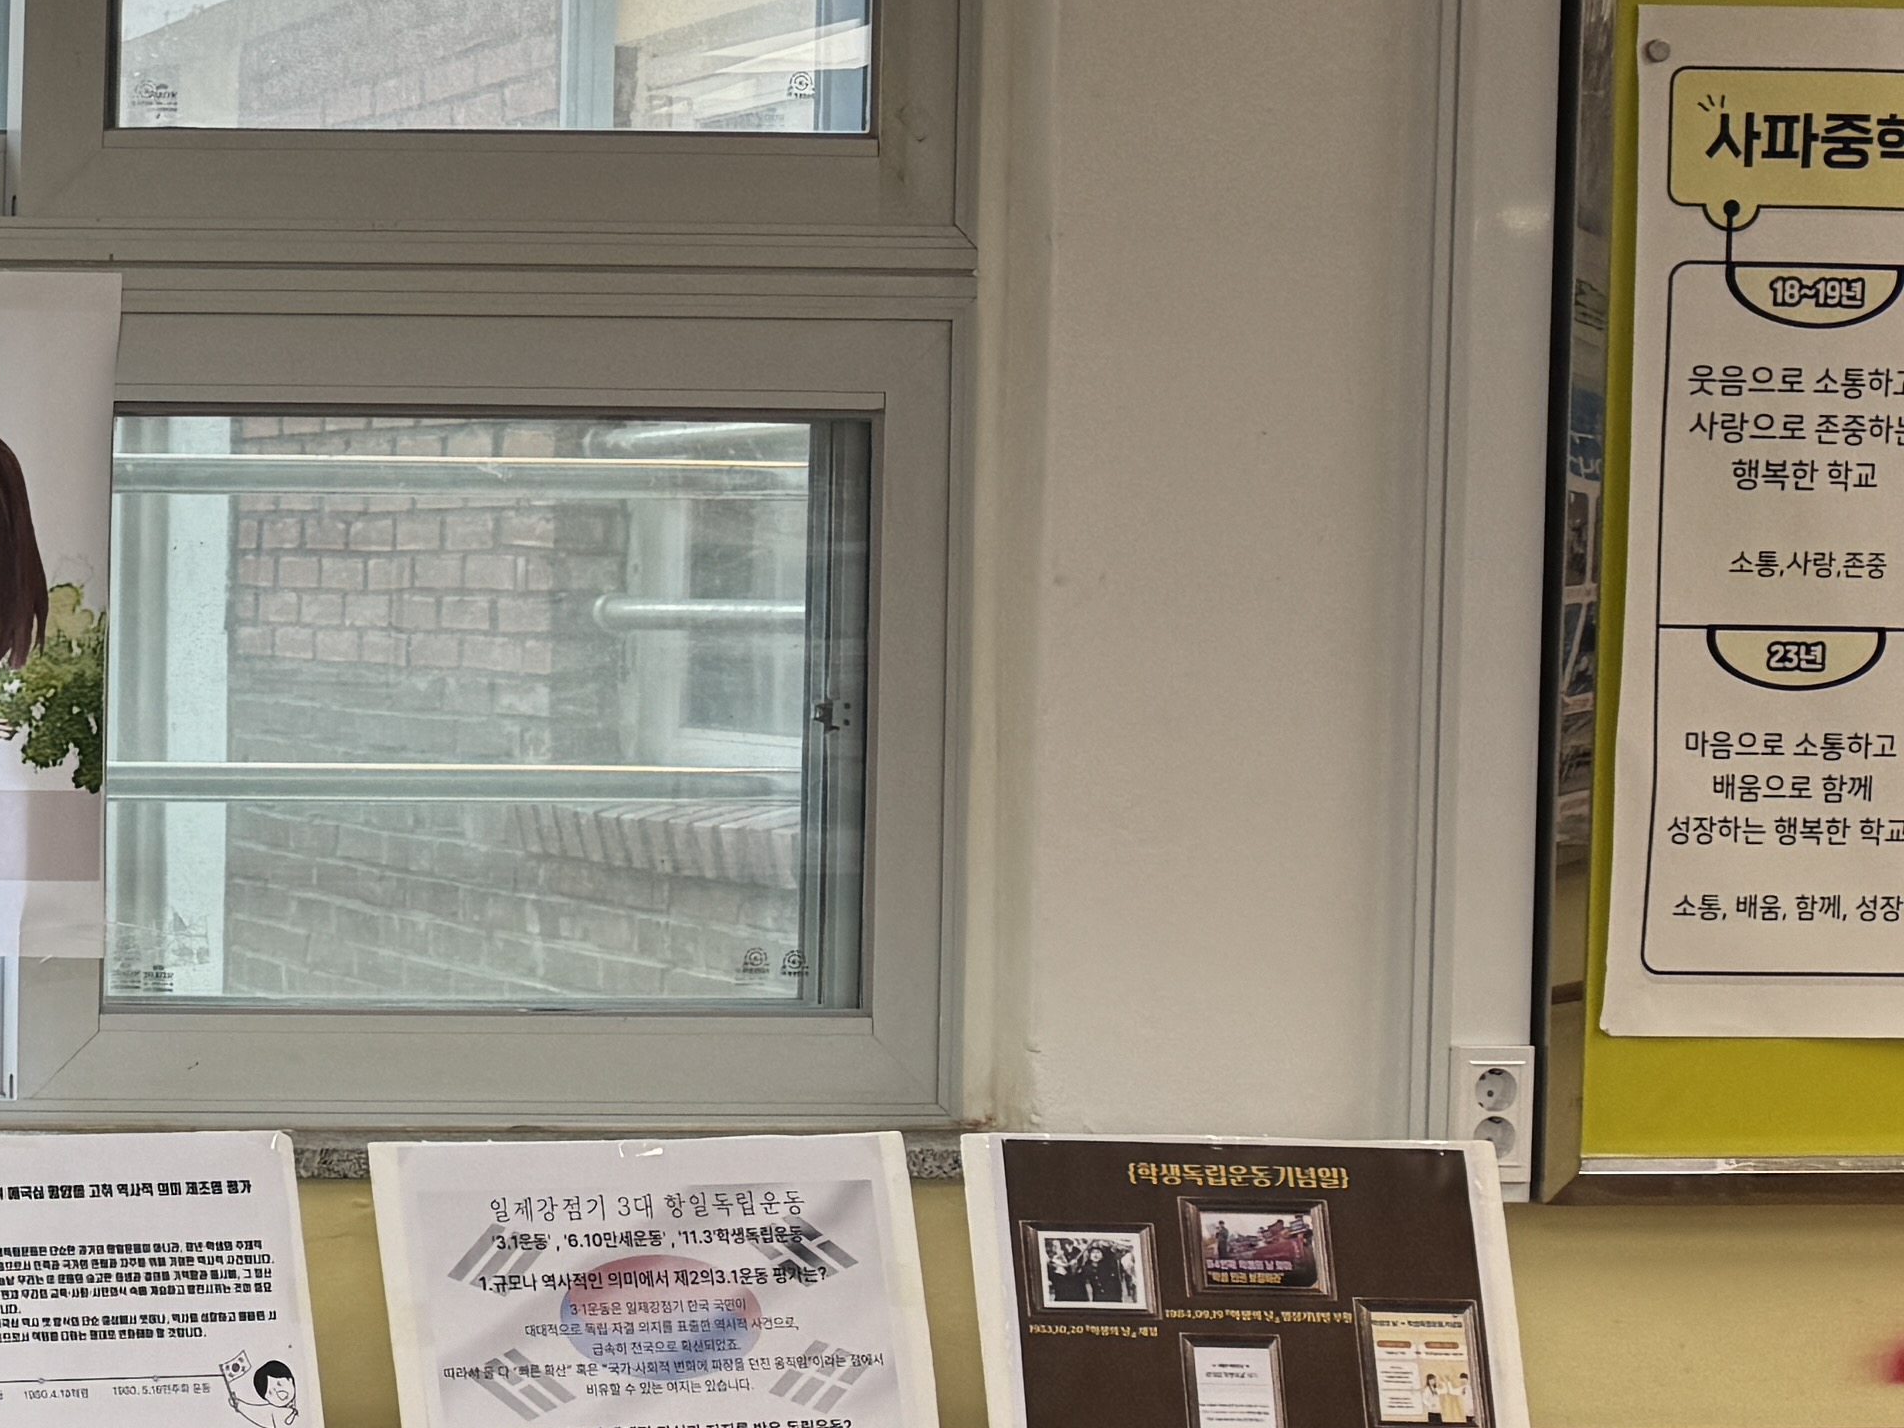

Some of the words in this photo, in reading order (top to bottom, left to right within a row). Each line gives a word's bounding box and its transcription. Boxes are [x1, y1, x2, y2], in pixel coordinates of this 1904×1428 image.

[1769, 276, 1865, 309] 18~19년
[1688, 365, 1805, 398] 웃음으로
[1689, 411, 1806, 444] 사랑으로
[1732, 459, 1819, 492] 행복한
[1827, 460, 1878, 492] 학교
[1729, 551, 1887, 579] 소통,사랑,존중
[1767, 641, 1826, 672] 23년
[1685, 731, 1785, 760] 마음으로
[1793, 732, 1897, 761] 소통하고
[1713, 774, 1812, 802] 배움으로
[1822, 774, 1873, 803] 함께
[1667, 816, 1766, 846] 성장하는
[1774, 816, 1851, 846] 행복한
[1859, 817, 1904, 846] 학교
[1672, 894, 1728, 921] 소통,
[1736, 894, 1787, 922] 배움,
[1796, 894, 1847, 922] 함께,
[1856, 895, 1904, 922] 성장
[490, 1194, 606, 1223] 일제강점기
[617, 1193, 655, 1219] 3대
[664, 1190, 805, 1219] 항일독립운동
[478, 1273, 537, 1293] 1.규모나
[542, 1272, 603, 1291] 역사적인
[608, 1270, 670, 1289] 의미에서
[674, 1267, 768, 1287] 제2의3.1운동
[586, 1383, 621, 1396] 비유할
[625, 1383, 636, 1395] 수
[639, 1382, 663, 1395] 있는
[667, 1380, 701, 1393] 여지는
